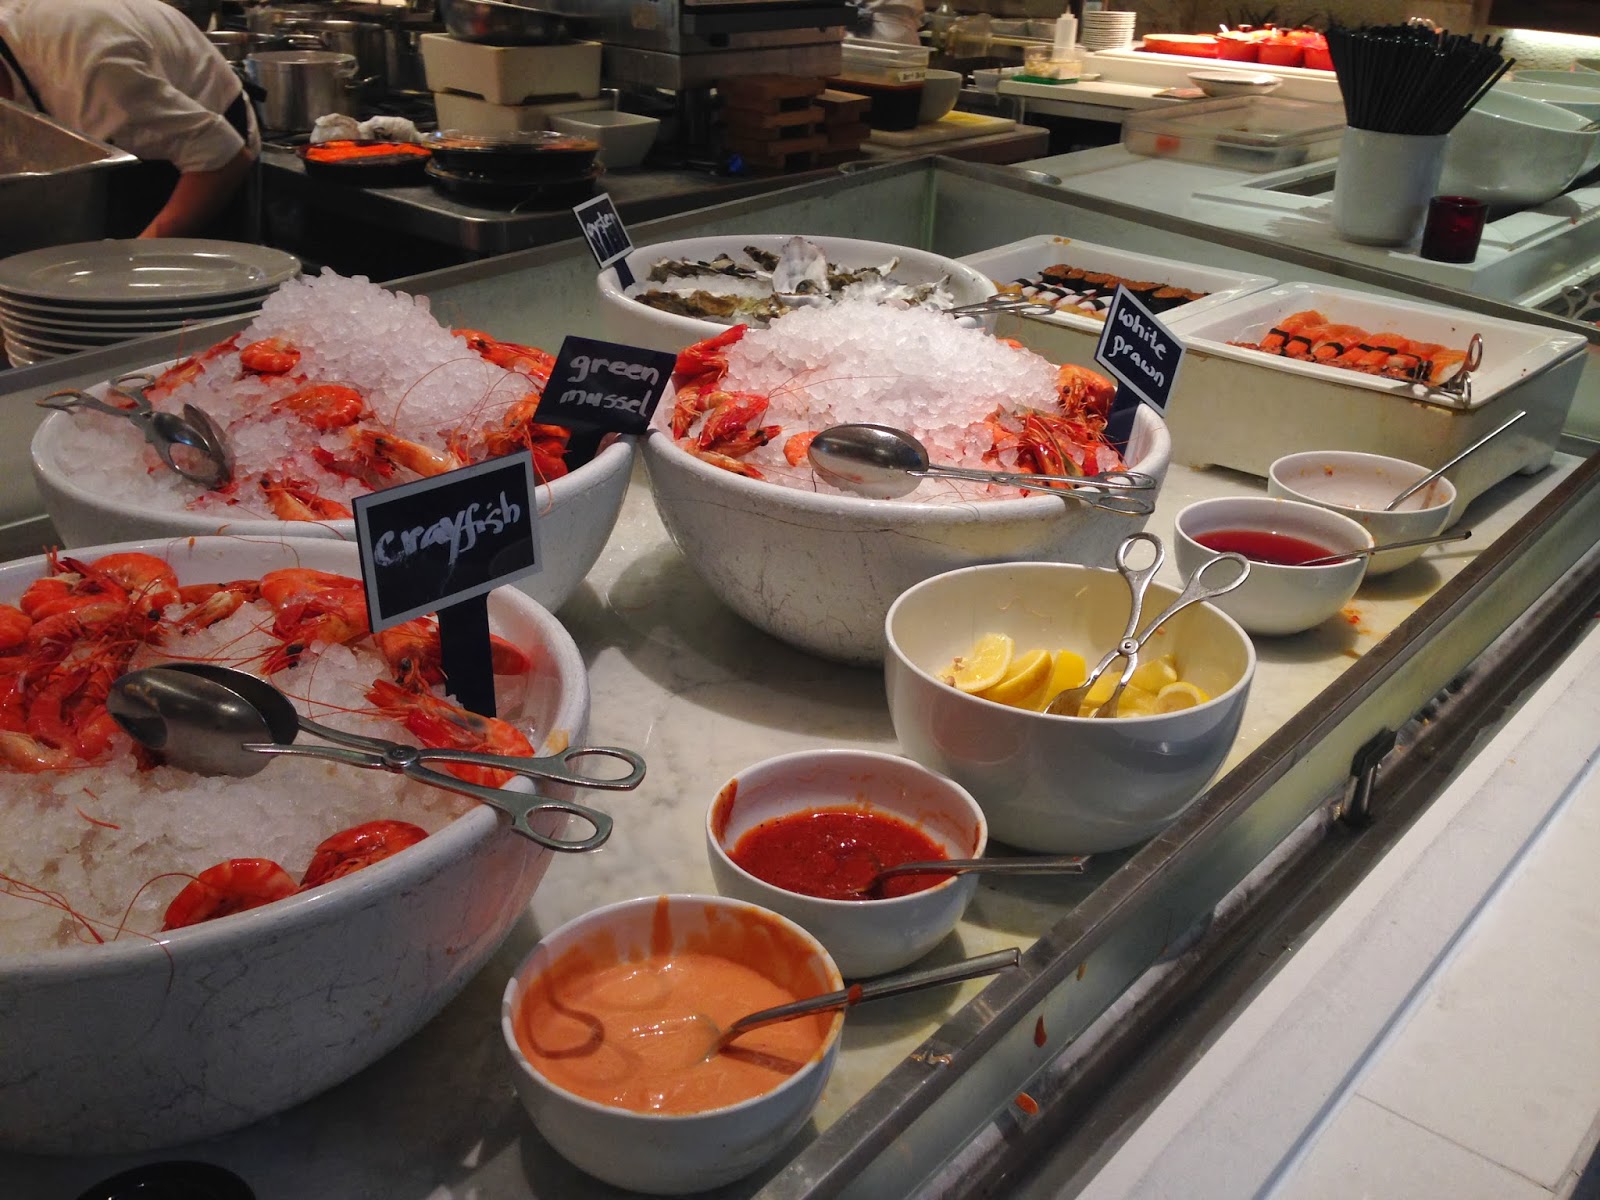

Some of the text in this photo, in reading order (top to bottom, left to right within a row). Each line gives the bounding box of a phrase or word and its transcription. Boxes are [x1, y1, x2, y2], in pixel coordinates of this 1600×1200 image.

[1118, 307, 1167, 360] white
[567, 355, 660, 386] green
[1108, 335, 1165, 388] prawn
[559, 389, 653, 418] mussel
